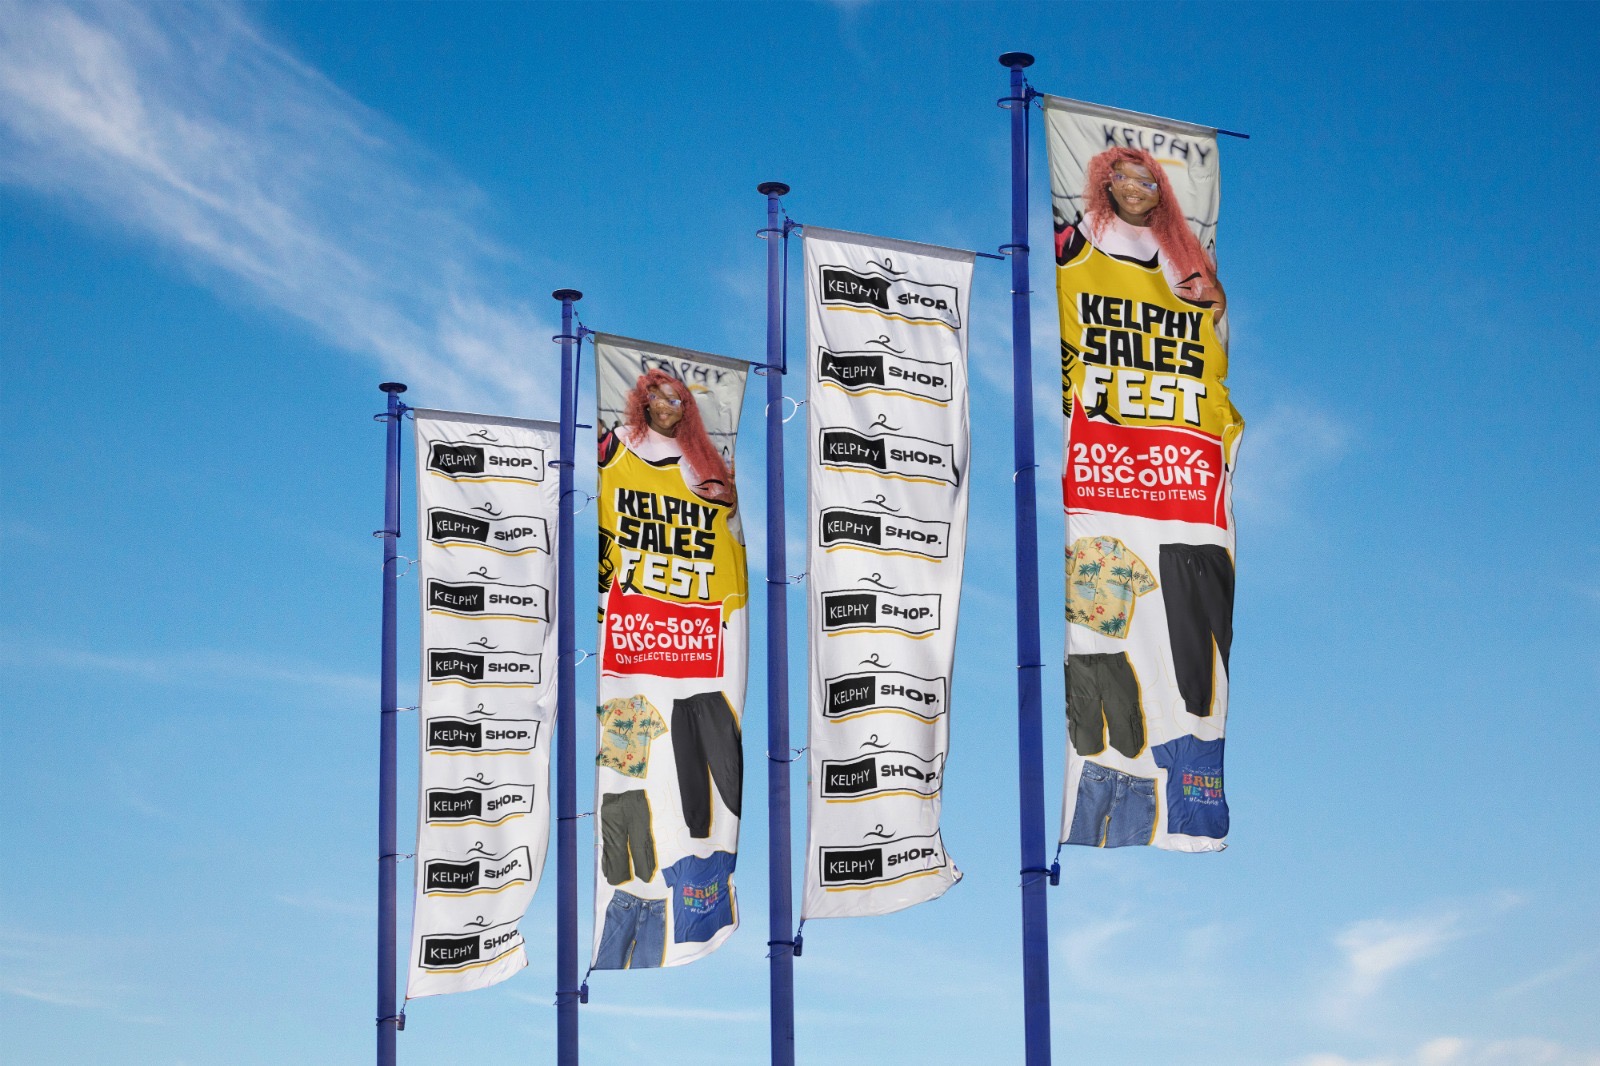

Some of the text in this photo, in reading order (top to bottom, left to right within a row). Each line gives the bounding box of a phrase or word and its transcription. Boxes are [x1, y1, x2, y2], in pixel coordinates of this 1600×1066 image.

[828, 279, 953, 314] KELPHY SHOP.
[1077, 292, 1204, 342] KELPHY
[1079, 326, 1205, 379] SALES
[827, 362, 947, 388] KELPHY SHOP.
[1081, 365, 1207, 427] FEST
[439, 453, 539, 470] KELPHY SHOP.
[829, 442, 946, 467] KELPHY SHOP.
[1073, 464, 1216, 487] DISCOUNT
[1077, 486, 1207, 502] ON SELECTED ITEMS
[614, 487, 719, 531] KELPHY
[436, 520, 537, 542] KELPHY SHOP.
[615, 515, 716, 560] SALES
[827, 520, 942, 545] KELPHY SHOP.
[619, 547, 715, 600] FEST
[434, 590, 538, 607] KELPHY SHOP.
[830, 603, 933, 620] KELPHY SHOP.
[611, 632, 717, 652] DISCOUNT
[435, 659, 534, 674] KELPHY SHOP.
[615, 651, 713, 665] ON SELECTED ITEMS
[834, 684, 939, 706] KELPHY SHOP.
[433, 729, 531, 742] KELPHY SHOP.
[830, 765, 940, 787] KELPHY SHOP.
[433, 794, 526, 812] KELPHY SHOP.
[432, 859, 522, 884] KELPHY SHOP.
[829, 848, 939, 874] KELPHY SHOP.
[430, 929, 520, 960] KELPHY SHOP.
